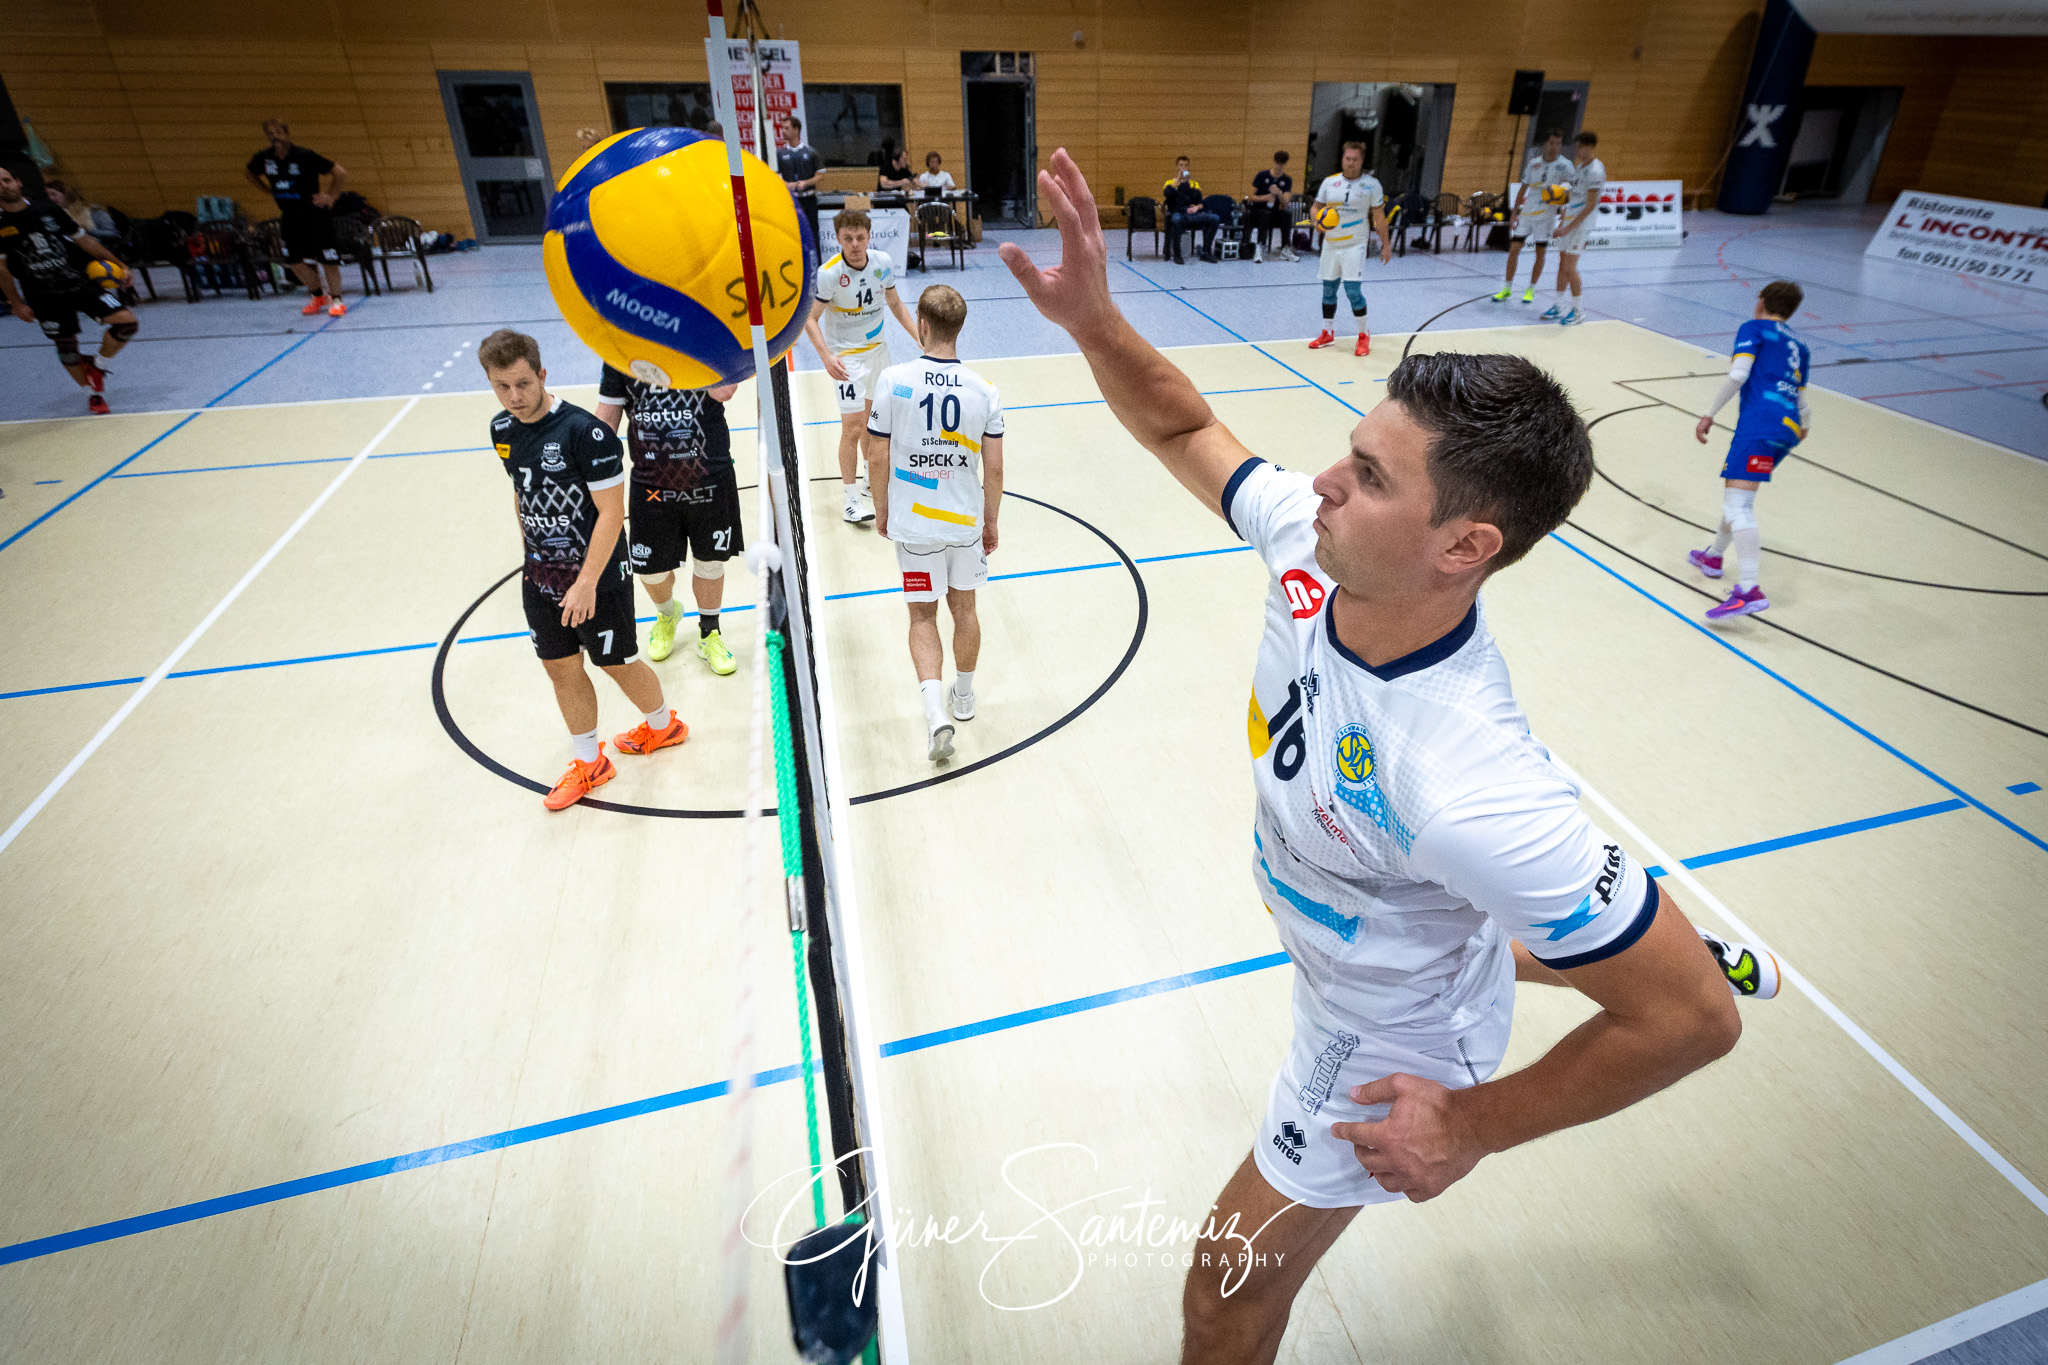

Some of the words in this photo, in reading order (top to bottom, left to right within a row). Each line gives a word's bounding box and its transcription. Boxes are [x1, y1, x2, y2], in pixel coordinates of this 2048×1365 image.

[1599, 186, 1675, 221] eiger
[1906, 196, 1994, 219] Ristorante
[856, 288, 873, 308] 14
[606, 288, 680, 333] V200W
[925, 372, 963, 387] ROLL
[839, 384, 856, 400] 14
[919, 393, 961, 433] 10
[930, 437, 959, 448] Schwaig
[909, 454, 954, 467] SPECK
[519, 467, 533, 493] 7
[909, 469, 955, 482] pumpen
[646, 484, 717, 502] XPACT
[712, 526, 732, 552] 21
[598, 629, 614, 656] 7
[1267, 678, 1306, 782] 16
